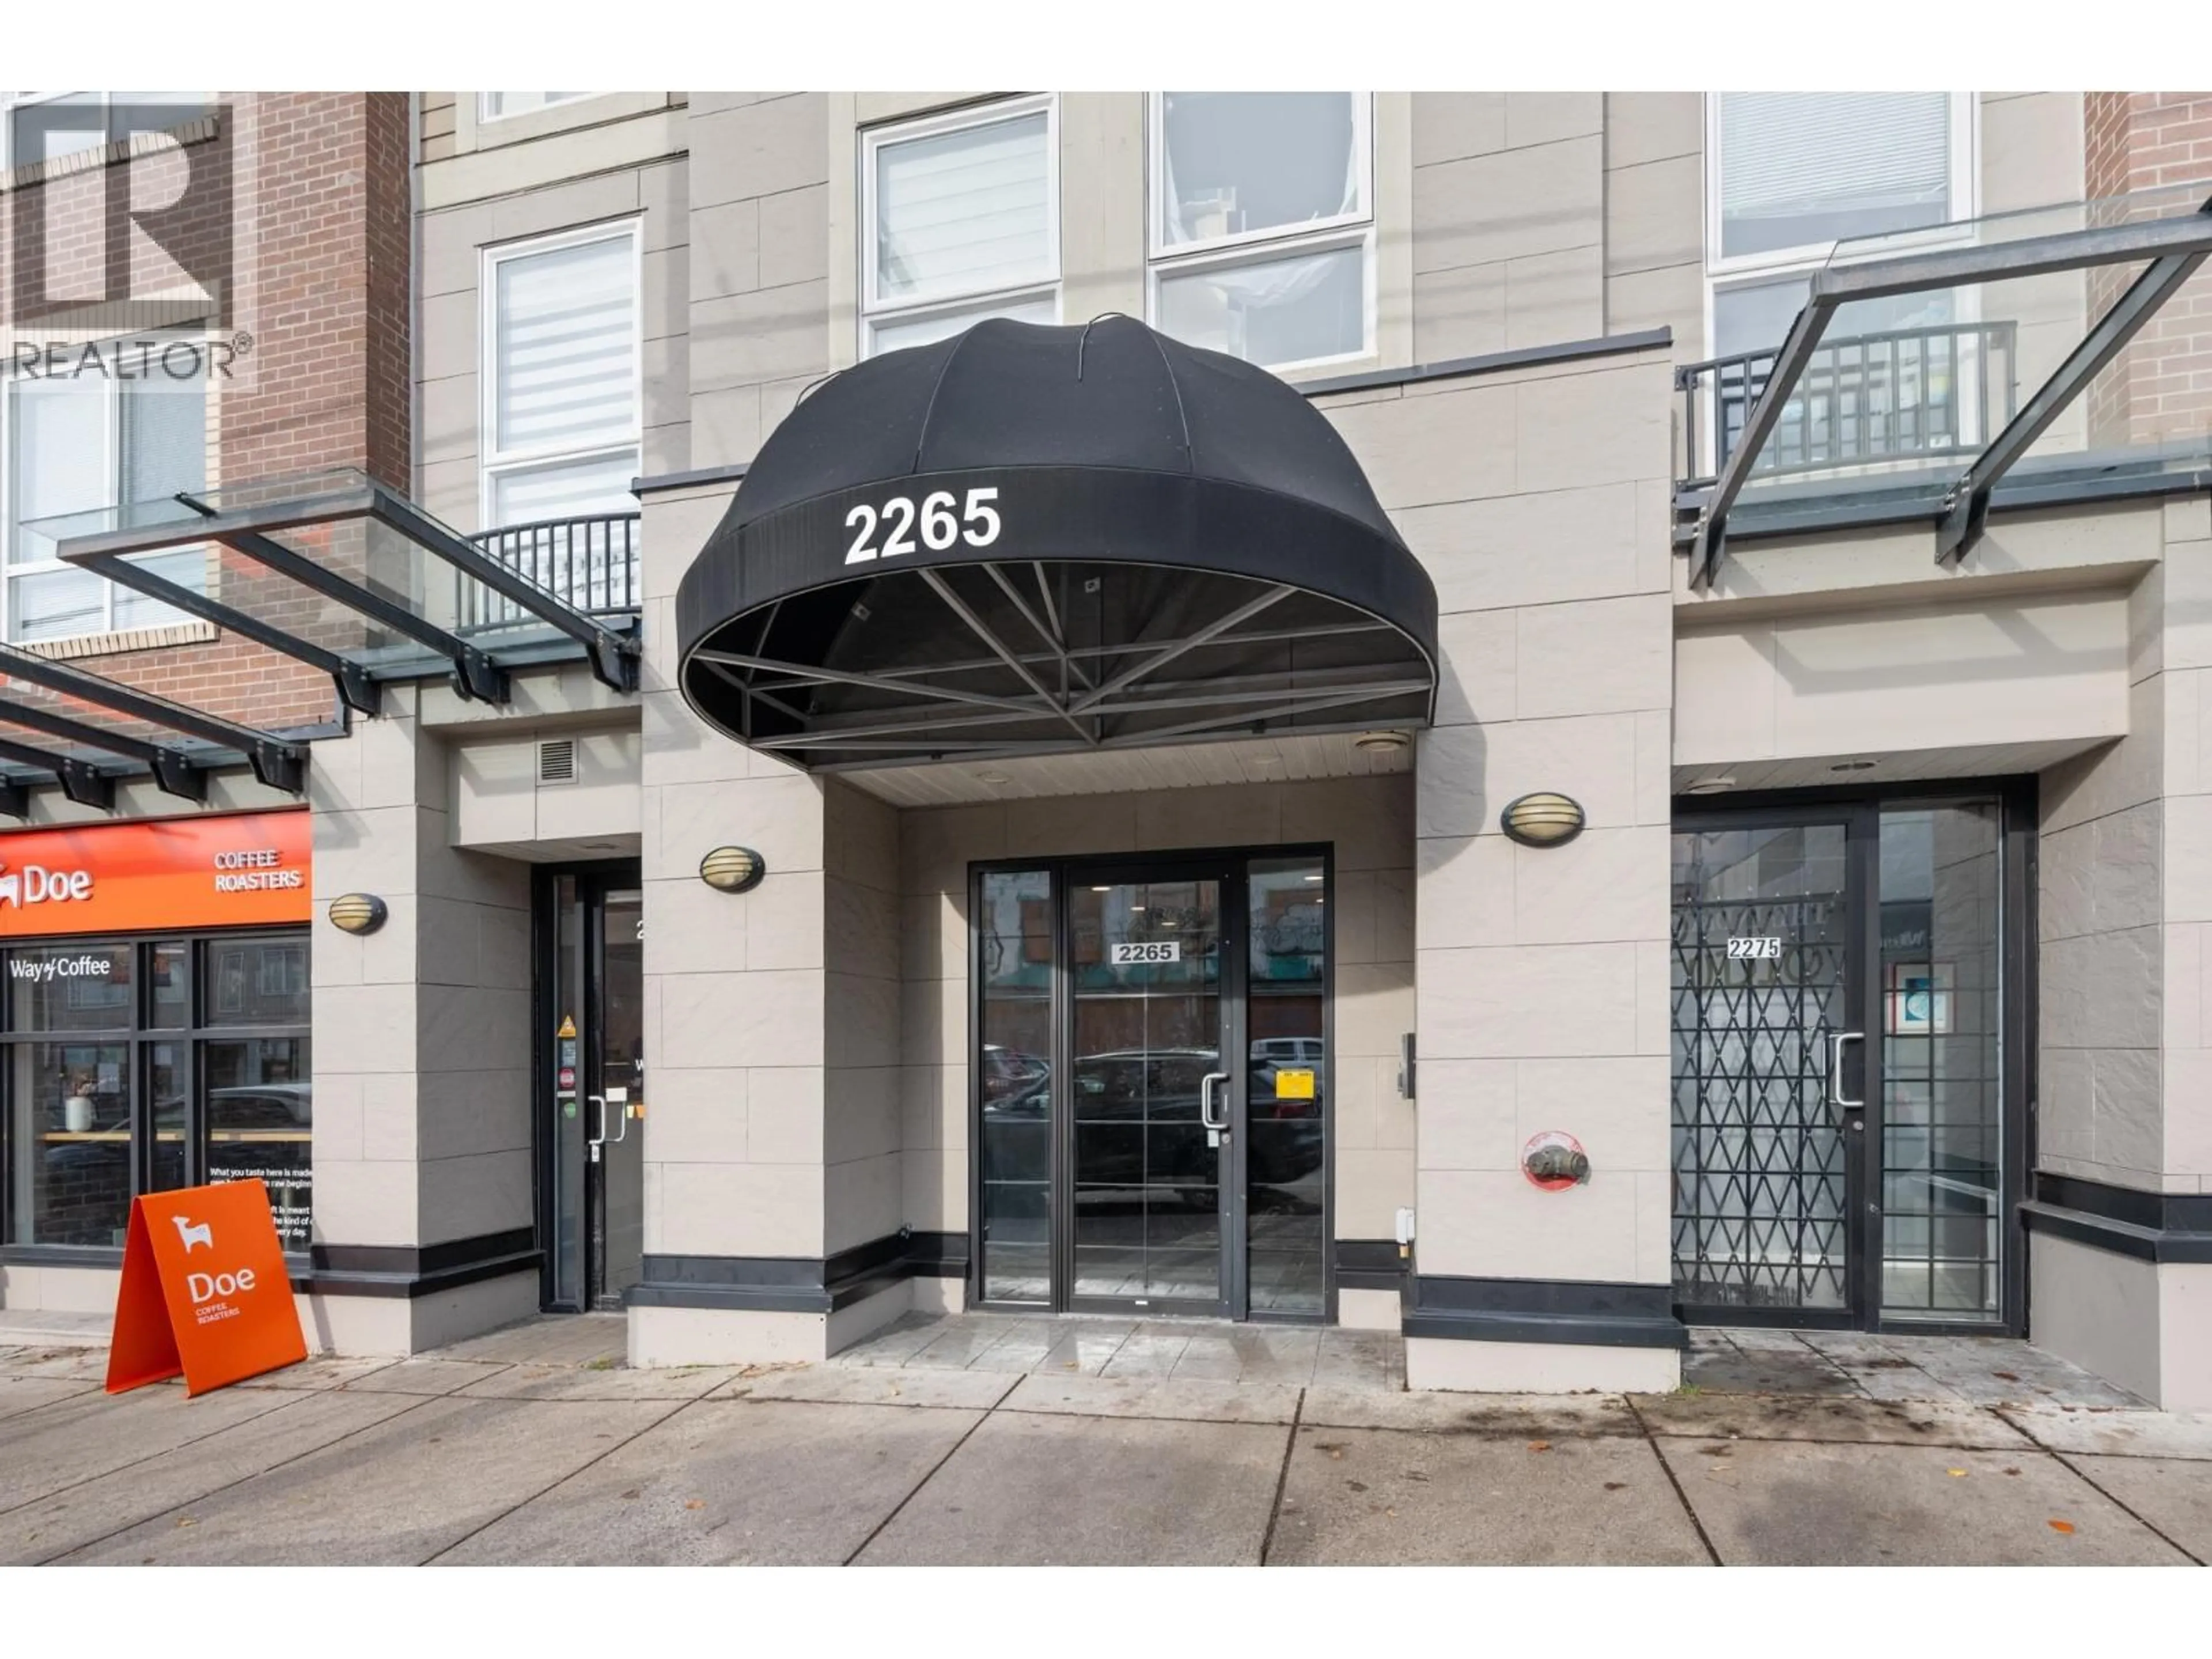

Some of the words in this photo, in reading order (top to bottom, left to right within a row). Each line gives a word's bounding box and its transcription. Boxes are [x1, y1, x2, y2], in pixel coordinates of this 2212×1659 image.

[844, 487, 1001, 565] 2265
[214, 850, 281, 869] COFFEE
[23, 865, 92, 903] Doe
[215, 869, 302, 892] ROASTERS
[1119, 944, 1172, 961] 2265
[1730, 939, 1779, 957] 2275
[10, 959, 43, 983] Way
[43, 957, 56, 981] of
[57, 955, 111, 976] Coffee
[210, 1168, 229, 1176] What
[230, 1169, 244, 1178] you
[246, 1168, 264, 1176] taste
[266, 1168, 283, 1176] here
[283, 1168, 290, 1176] is
[187, 1268, 255, 1304] Doe
